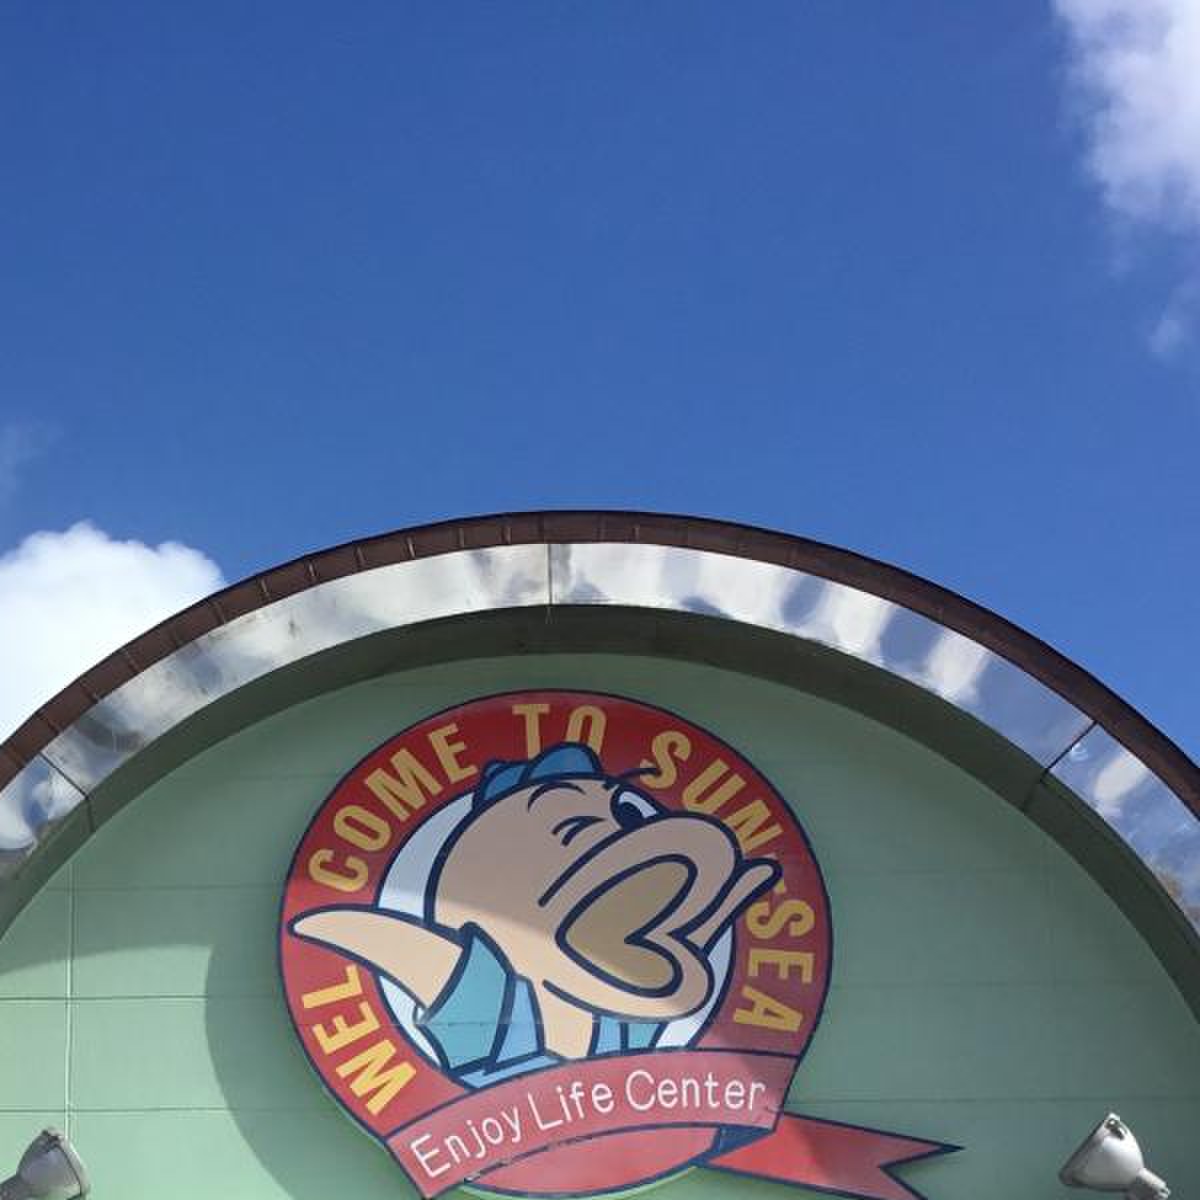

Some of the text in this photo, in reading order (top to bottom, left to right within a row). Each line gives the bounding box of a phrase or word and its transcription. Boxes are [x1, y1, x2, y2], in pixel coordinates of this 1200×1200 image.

[512, 703, 607, 760] TO
[410, 1070, 767, 1179] Enjoy Life Center
